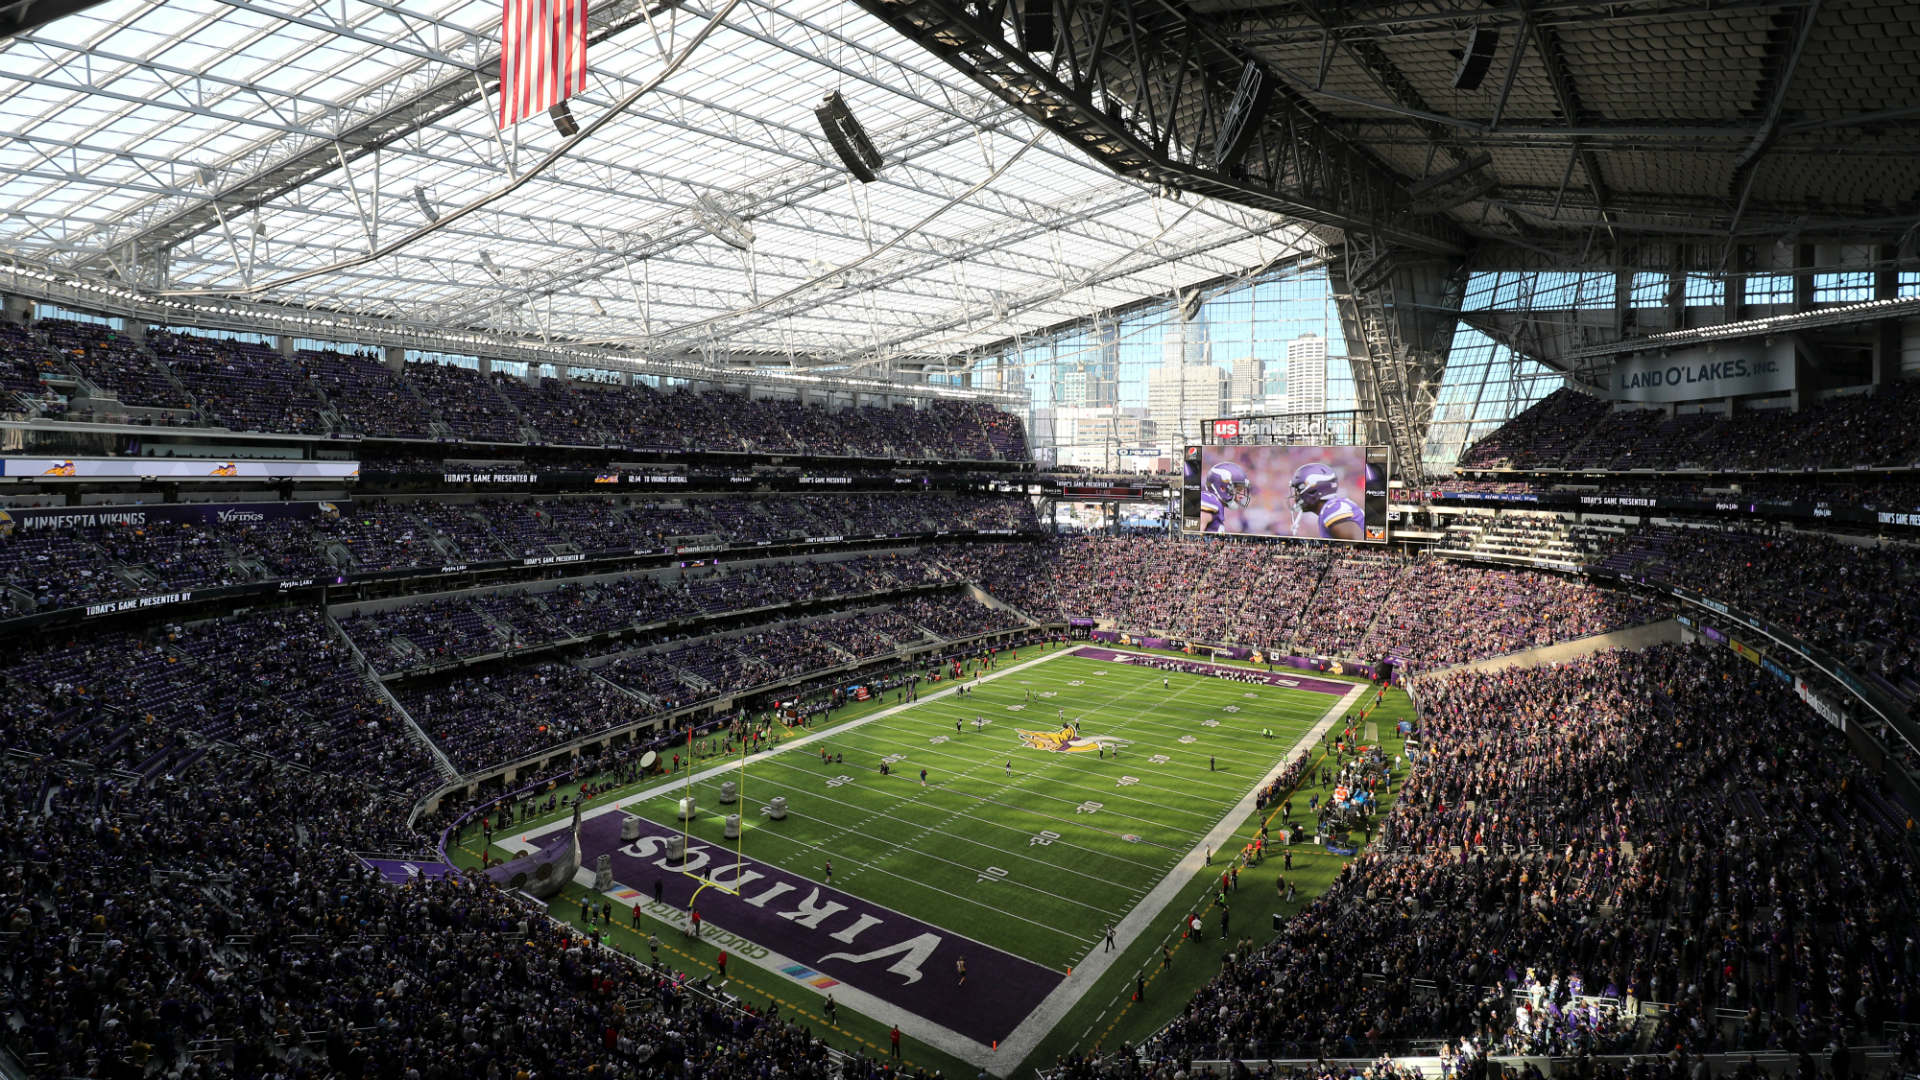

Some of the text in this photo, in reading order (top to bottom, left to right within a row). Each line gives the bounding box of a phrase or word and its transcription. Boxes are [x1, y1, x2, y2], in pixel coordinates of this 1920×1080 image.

[1621, 370, 1663, 390] LAND
[1753, 361, 1779, 376] INC.
[444, 474, 538, 483] TODAY'S GAME PRESENTED BY
[1604, 496, 1617, 505] GAME
[1619, 497, 1648, 507] PRESENTED
[1649, 499, 1656, 507] BY
[23, 512, 146, 529] MINNESOTA VIKINGS
[86, 592, 191, 616] TODAY'S GAME PRESENTED BY
[1029, 830, 1061, 848] 20
[975, 865, 1009, 884] 10
[642, 901, 769, 960] ATCH CRUCIAL
